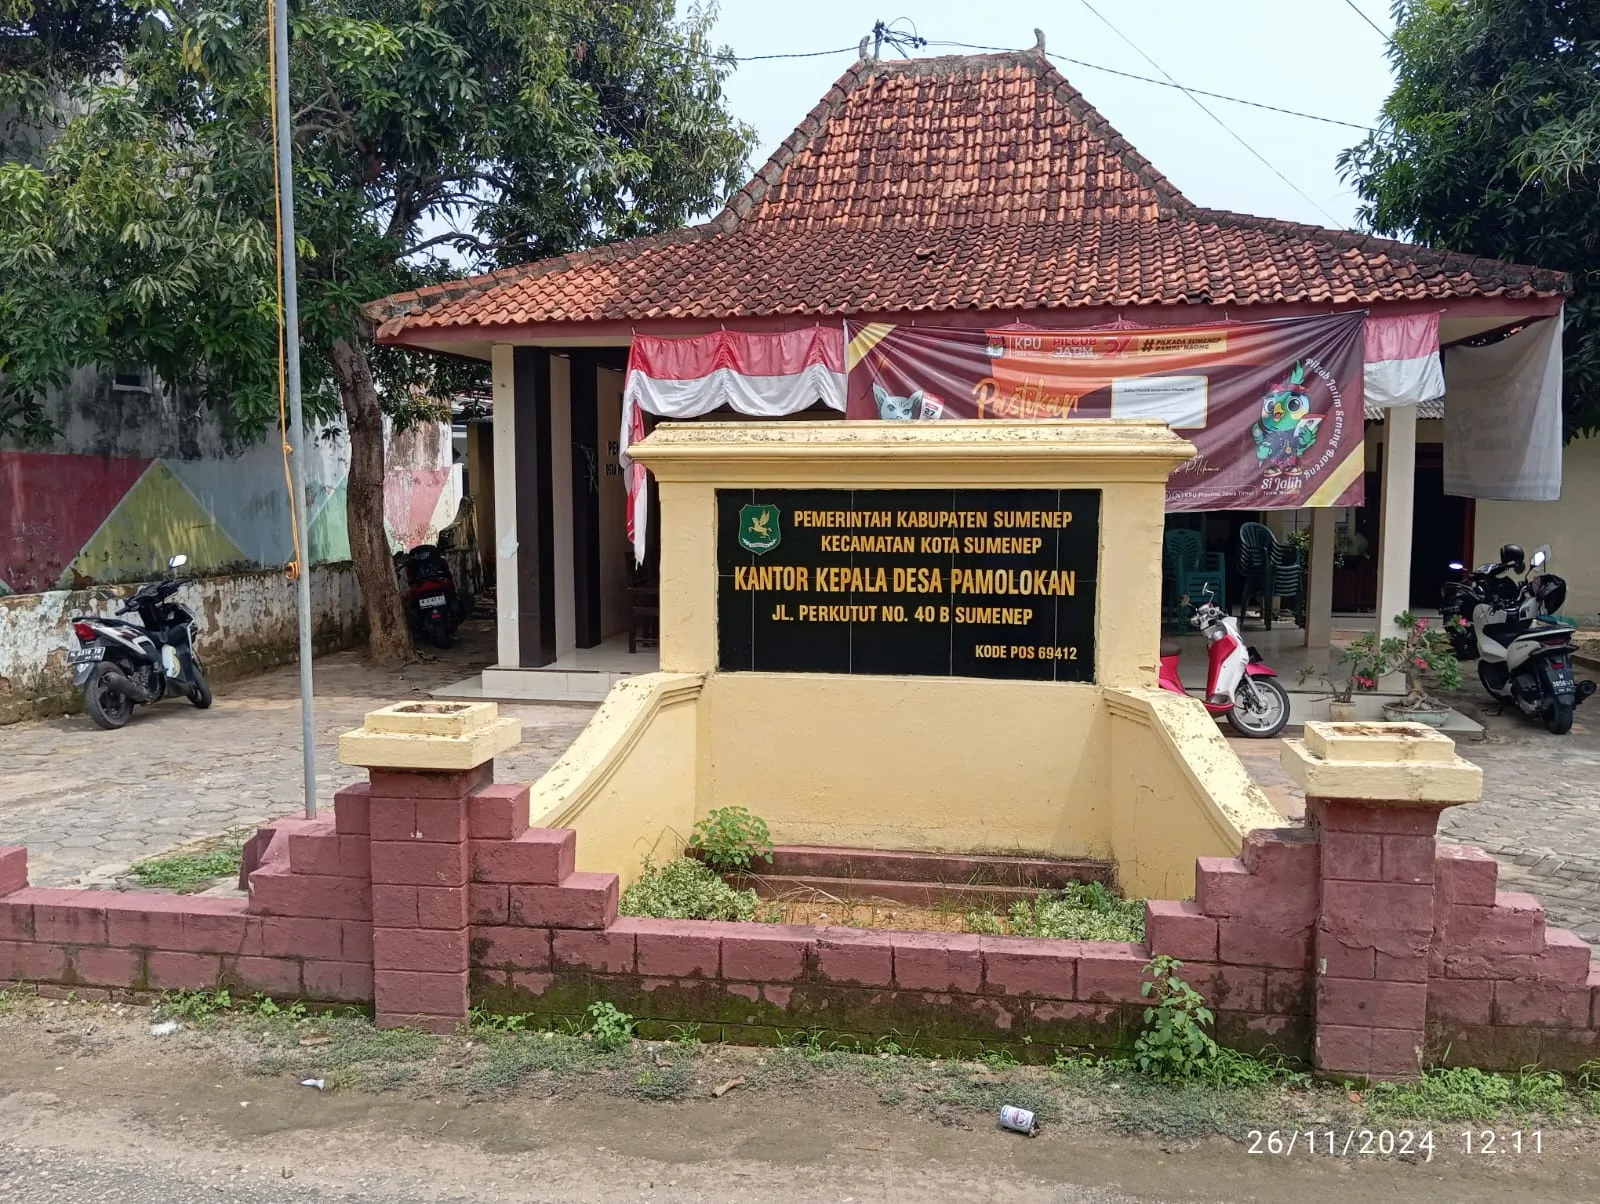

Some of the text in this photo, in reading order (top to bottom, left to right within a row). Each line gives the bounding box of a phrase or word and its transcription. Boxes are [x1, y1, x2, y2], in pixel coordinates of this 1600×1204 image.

[1015, 337, 1042, 350] KPU
[1053, 338, 1097, 347] PILGUB
[1303, 358, 1344, 481] Pilgub Jatim Seneng Bareng
[1261, 475, 1303, 492] Si Jalih
[793, 510, 1073, 529] PEMERINTAH KABUPATEN SUMENEP
[821, 535, 1043, 554] KECAMATAN KOTA SUMENEP
[734, 566, 1076, 596] KANTOR KEPALA DESA PAMOLOKAN
[772, 604, 1033, 625] JL. PERKUTUT NO. 40 B SUMENEP
[975, 644, 1078, 661] KODE POS 69412
